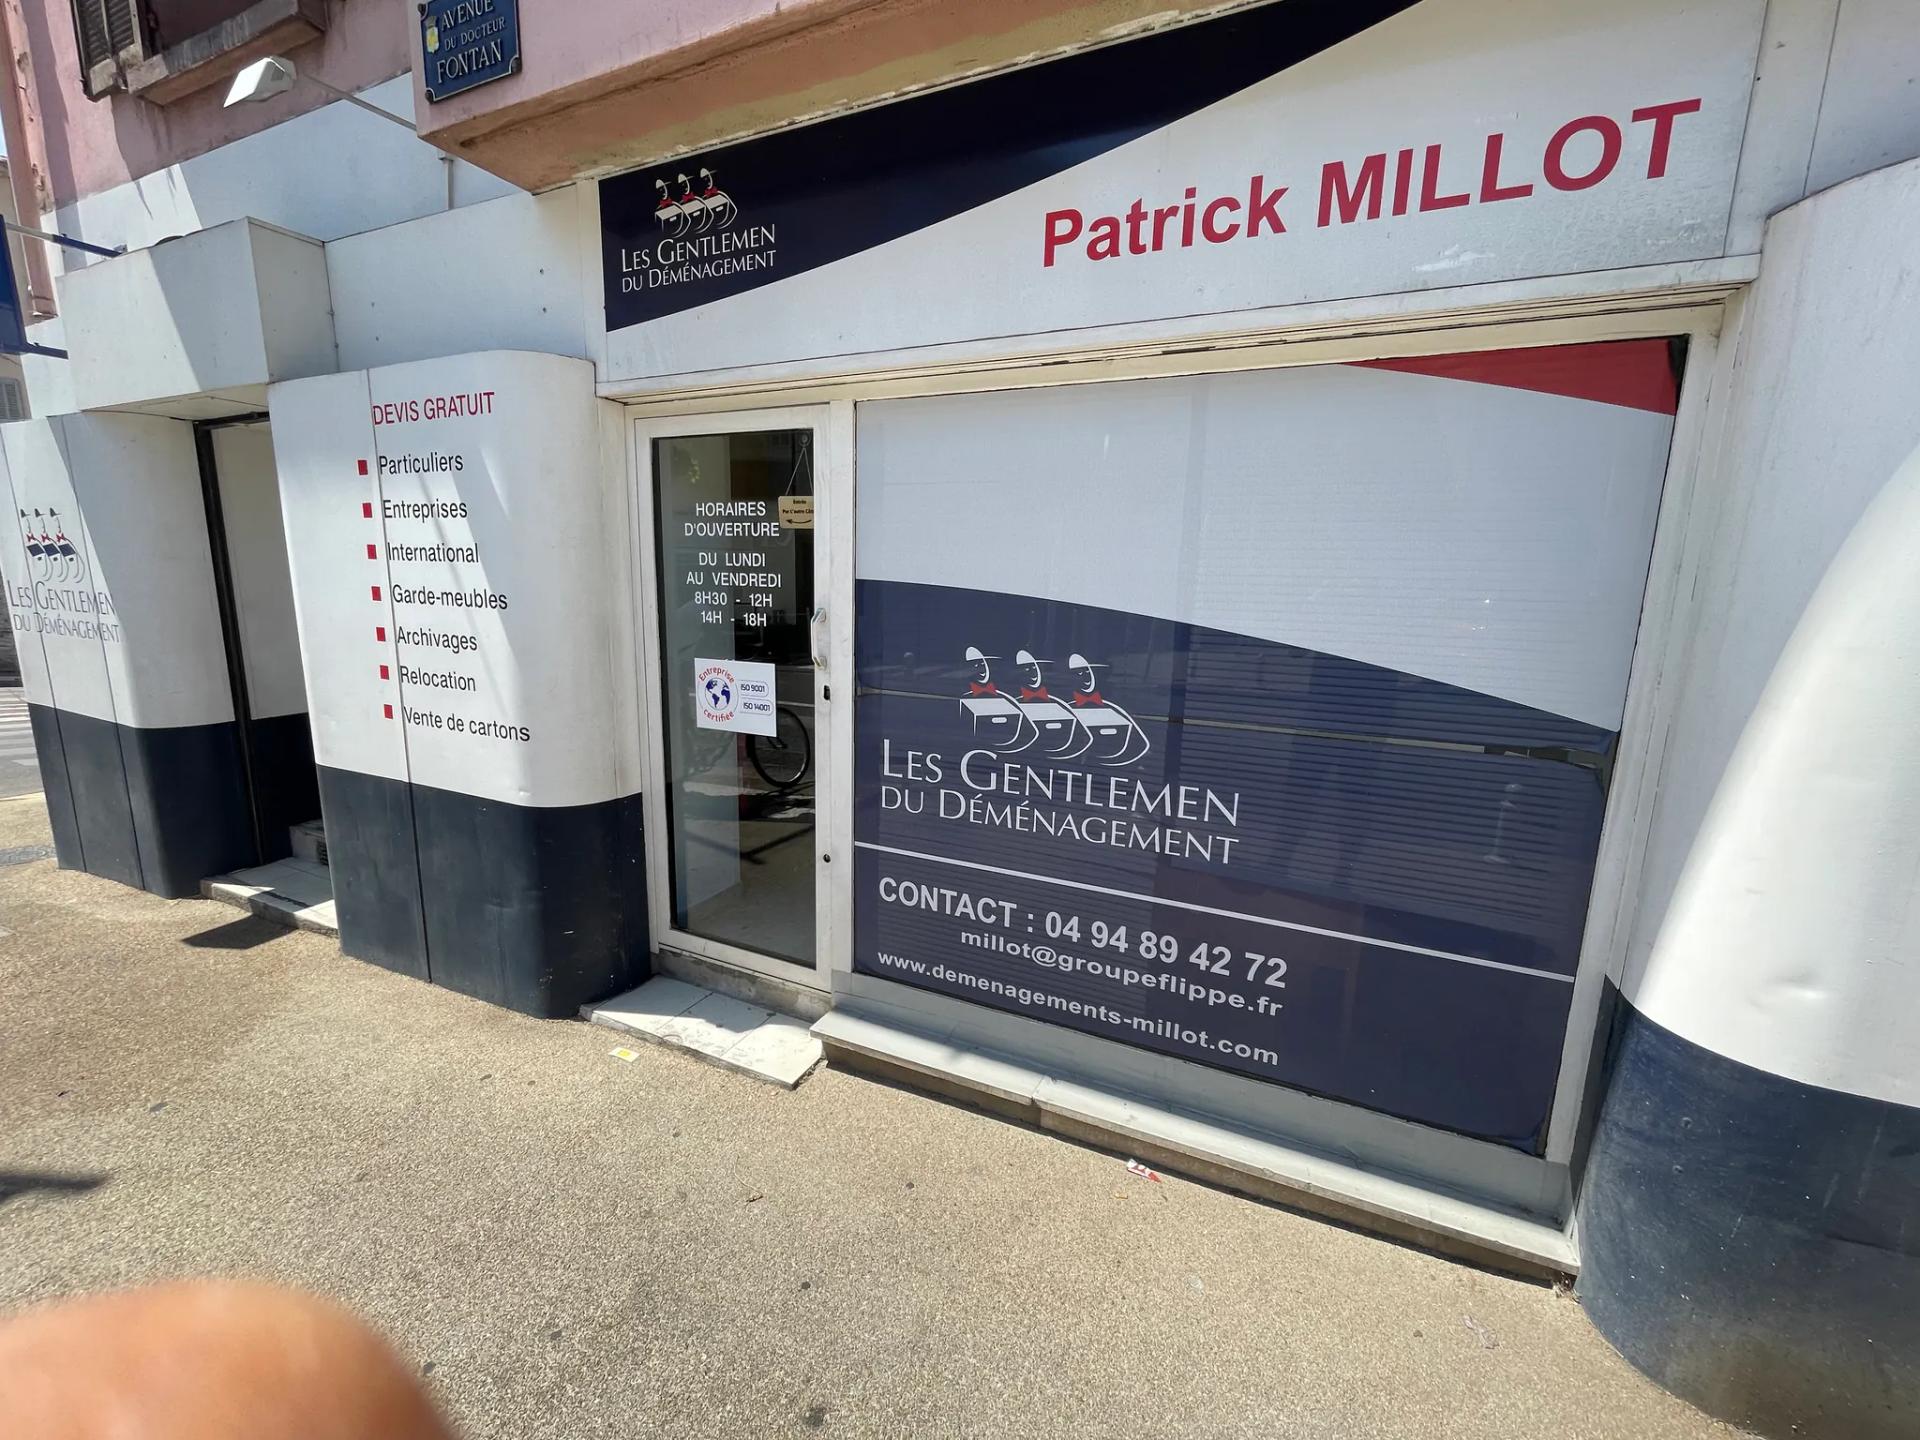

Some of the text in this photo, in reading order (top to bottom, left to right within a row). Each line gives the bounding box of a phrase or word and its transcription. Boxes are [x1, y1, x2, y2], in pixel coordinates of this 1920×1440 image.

[441, 0, 494, 31] AVENUE
[444, 17, 505, 51] DU DOCTEUR
[437, 39, 502, 83] FONTAN
[1044, 98, 1702, 268] Patrick MILLOT
[622, 275, 643, 293] DU
[372, 391, 495, 426] DEVIS GRATUIT
[379, 452, 464, 475] Particuliers
[383, 498, 468, 523] Entreprises
[695, 501, 766, 517] HORAIRES
[684, 522, 780, 537] D'OUVERTURE
[387, 542, 479, 563] International
[698, 552, 766, 567] DU LUNDI
[686, 571, 781, 588] AU VENDREDI
[392, 584, 508, 610] Garde-meubles
[694, 591, 728, 606] 8H30
[748, 593, 773, 608] 12H
[700, 610, 722, 624] 14H
[743, 612, 767, 627] 18H
[397, 626, 478, 654] Archivages
[399, 665, 477, 692] Relocation
[698, 666, 735, 684] Entreprise
[740, 683, 766, 693] ISO 9001
[743, 702, 771, 712] ISO 14001
[403, 706, 531, 742] Vente de cartons
[880, 785, 925, 814] DU
[878, 876, 1017, 929] CONTACT
[1045, 911, 1081, 943] 04
[1090, 921, 1129, 953] 94
[1138, 931, 1179, 963] 89
[1188, 942, 1231, 977] 42
[1244, 952, 1288, 989] 72
[961, 930, 1284, 1018] millot@groupeflippe.fr
[878, 951, 1279, 1066] www.demenagements-millot.com
